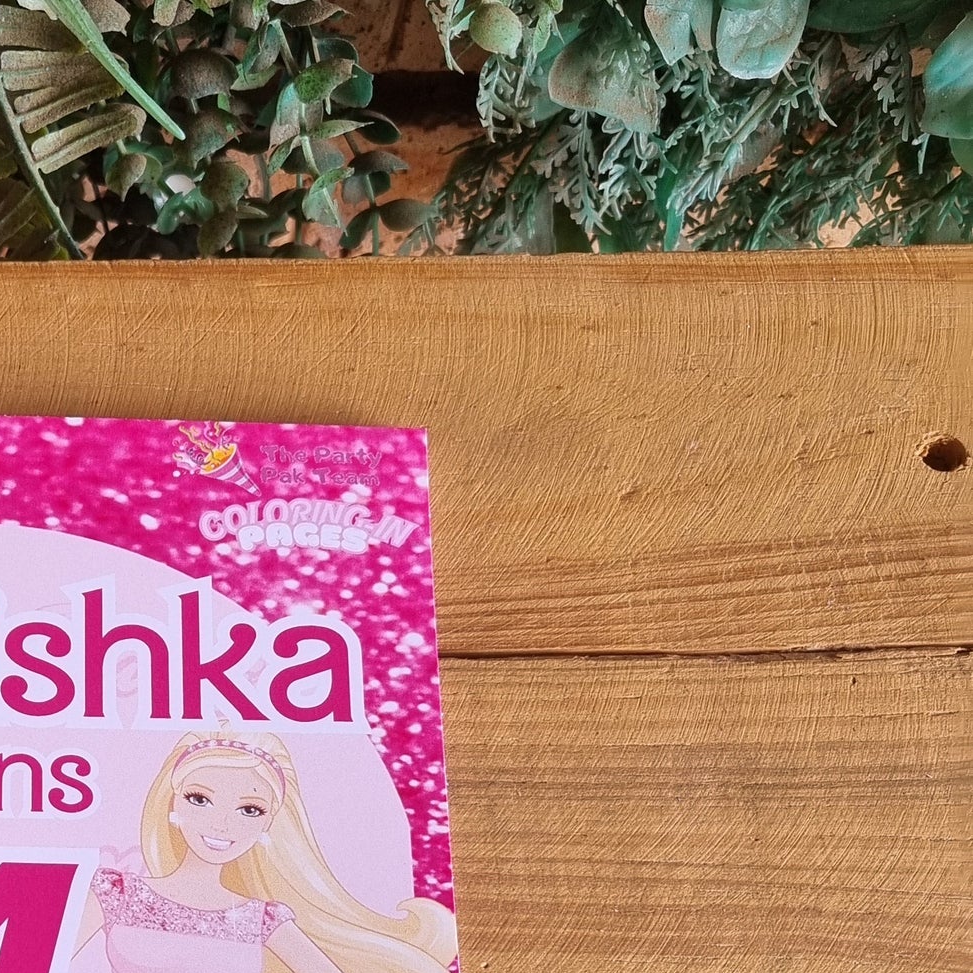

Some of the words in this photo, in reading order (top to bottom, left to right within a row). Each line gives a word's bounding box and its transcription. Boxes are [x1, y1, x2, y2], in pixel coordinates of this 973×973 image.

[260, 445, 308, 462] The
[314, 446, 381, 469] Party
[261, 466, 306, 484] Pak
[311, 467, 380, 486] Team
[237, 523, 368, 555] PAGES
